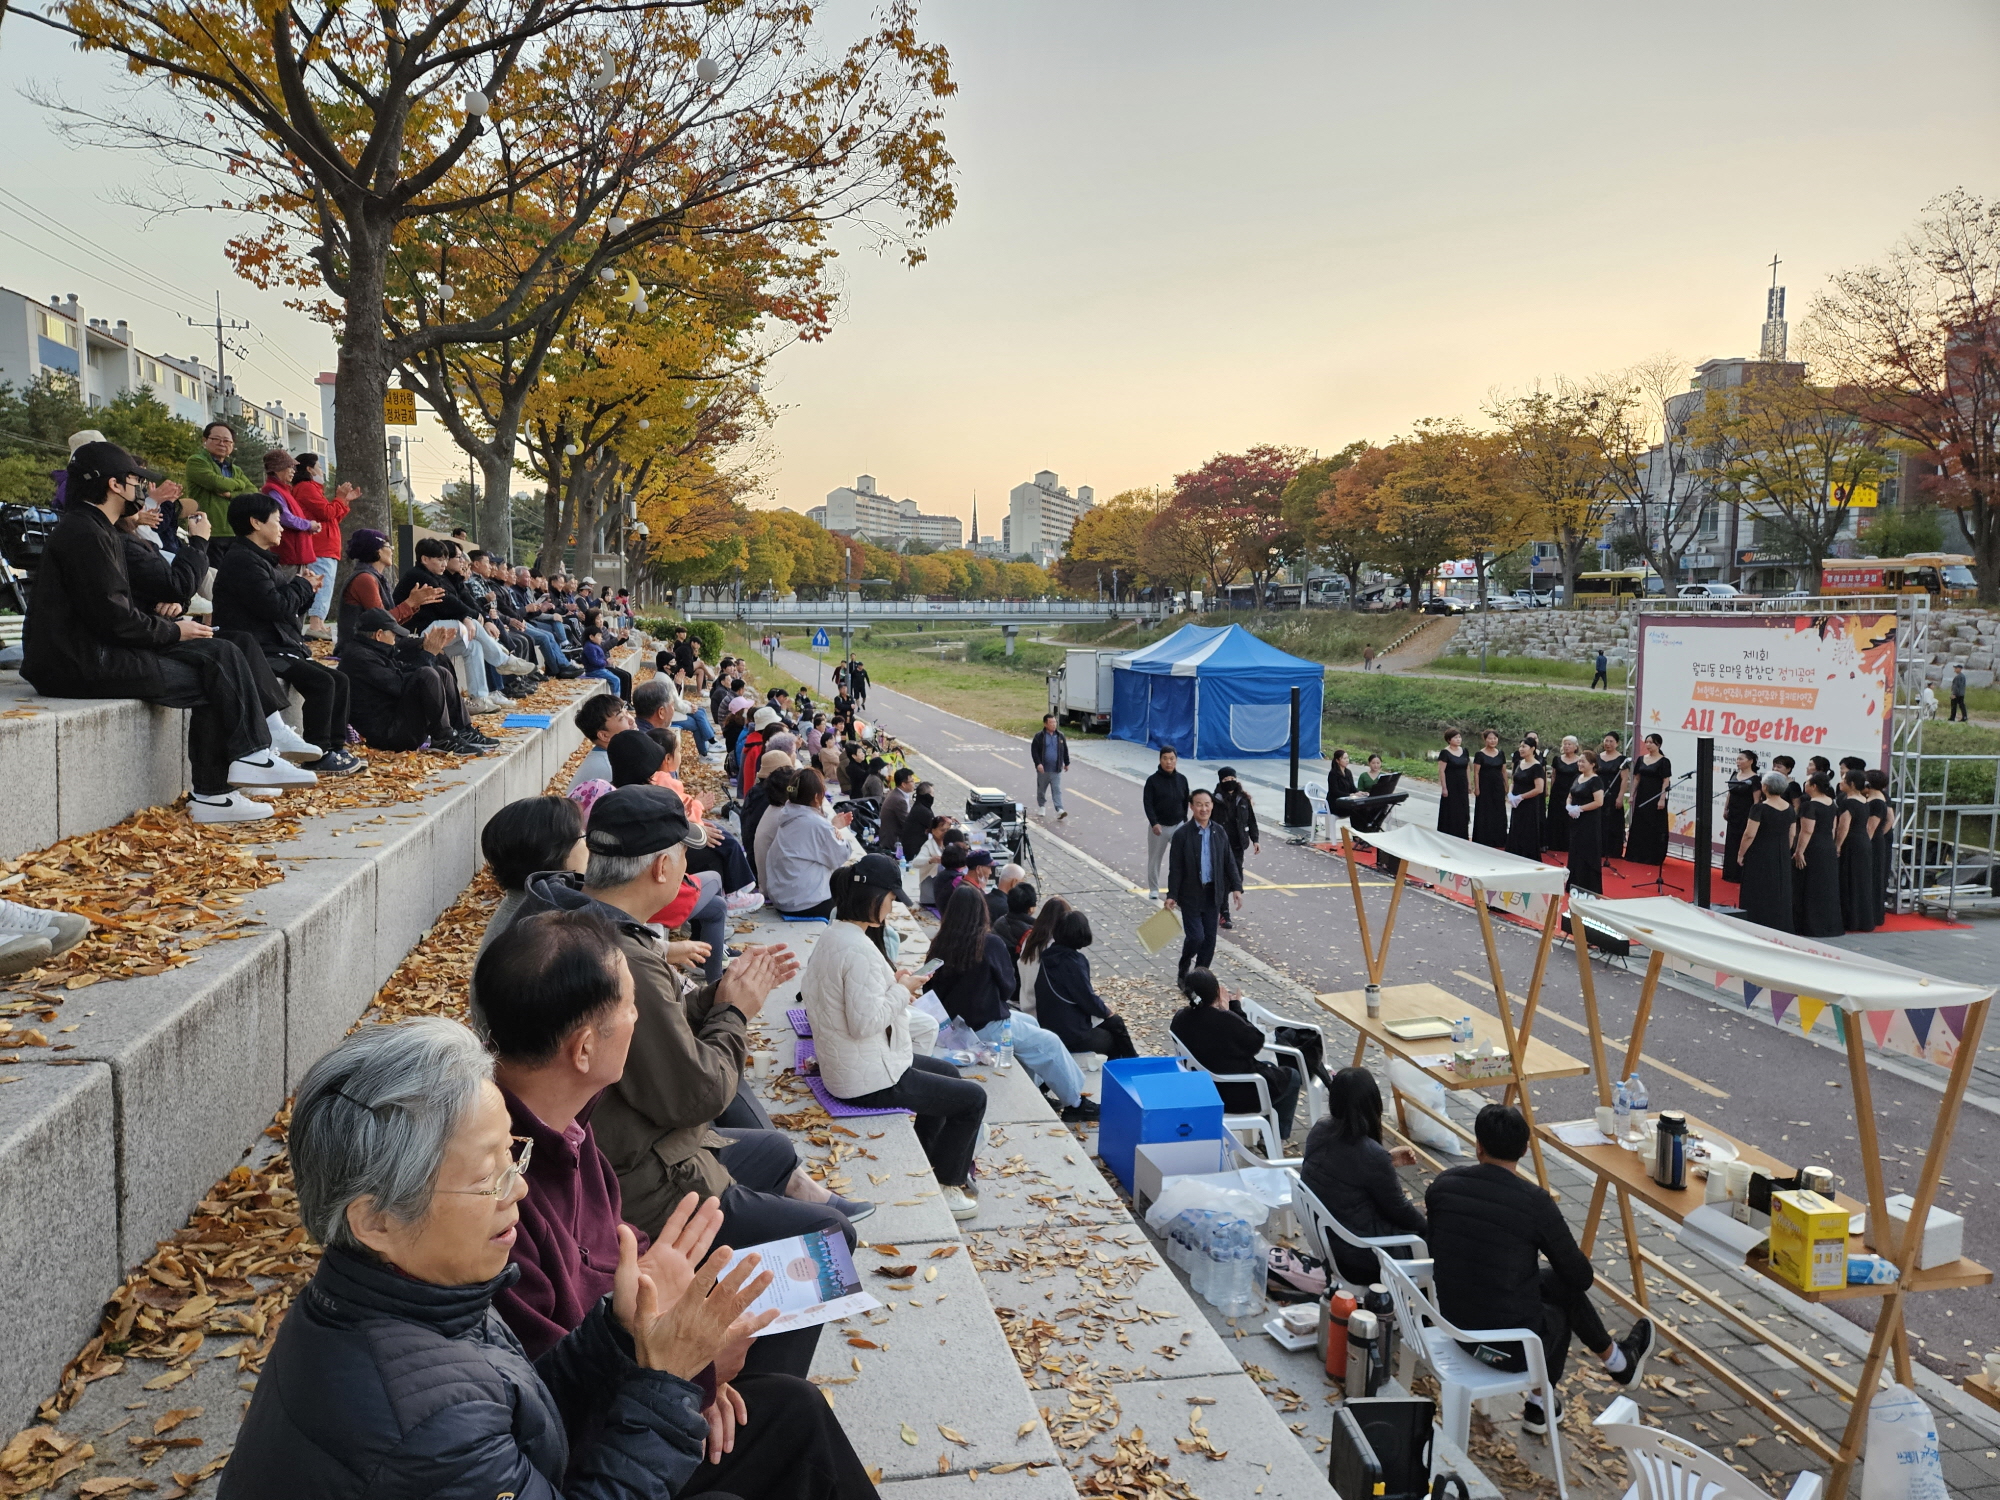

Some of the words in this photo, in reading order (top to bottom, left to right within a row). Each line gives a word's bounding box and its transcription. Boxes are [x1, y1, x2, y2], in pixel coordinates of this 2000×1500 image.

[384, 408, 415, 423] 정차금지
[1742, 649, 1769, 661] 제1회
[1692, 661, 1716, 677] 월피동
[1719, 663, 1742, 679] 온마을
[1744, 664, 1774, 681] 합창단
[1777, 667, 1816, 683] 정기공연
[1681, 707, 1715, 732] All
[1720, 711, 1828, 744] Together
